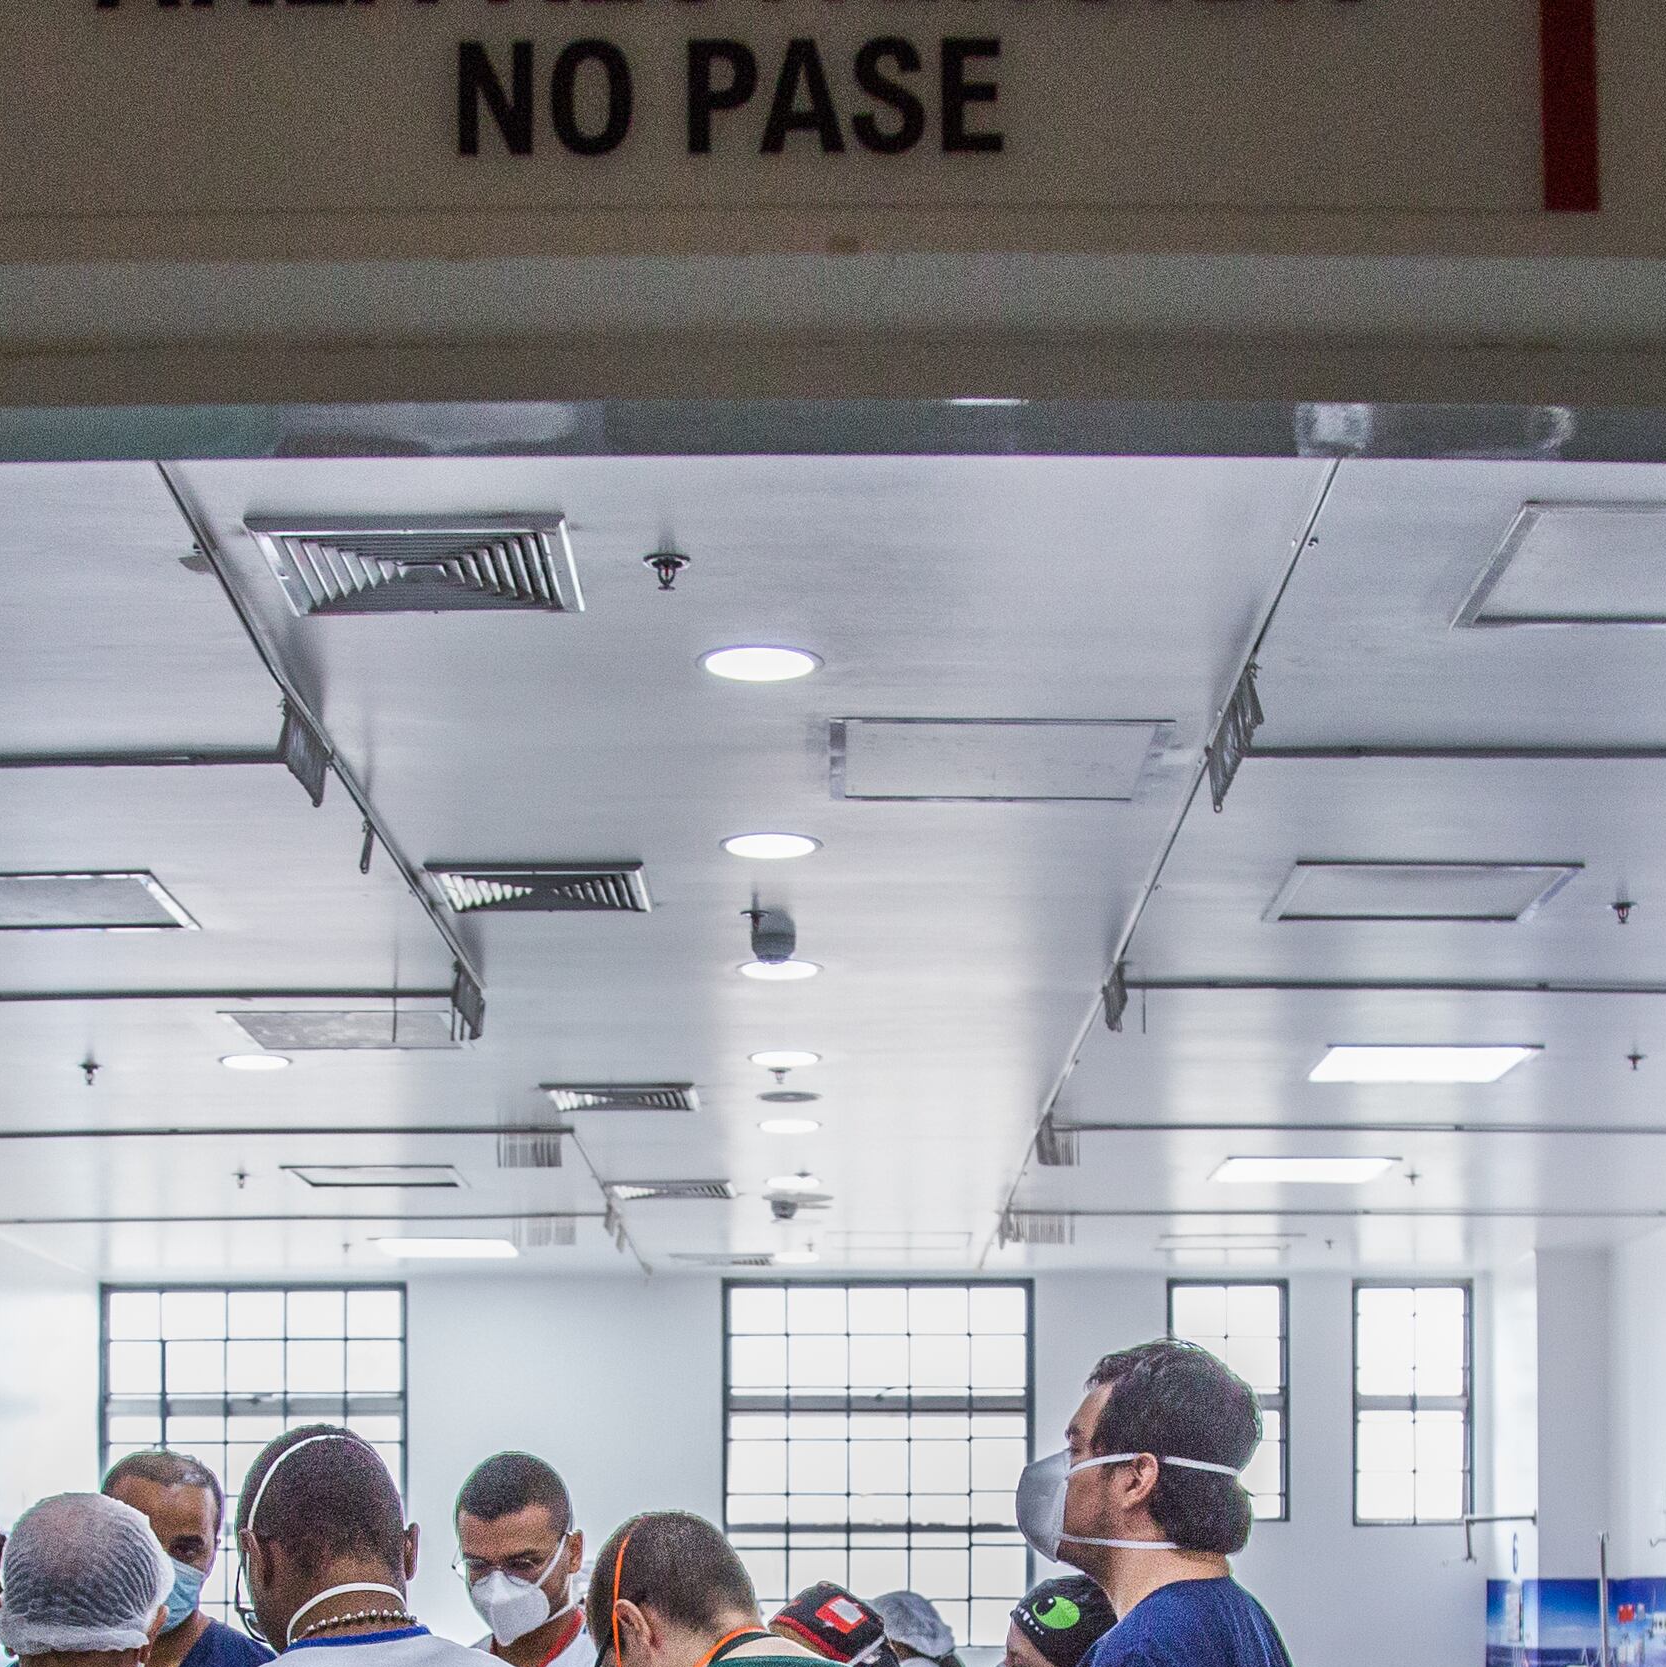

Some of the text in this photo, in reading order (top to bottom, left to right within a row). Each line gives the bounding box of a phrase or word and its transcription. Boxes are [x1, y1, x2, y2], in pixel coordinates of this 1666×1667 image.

[457, 35, 1004, 156] NO PASE
[1512, 1532, 1520, 1574] 6
